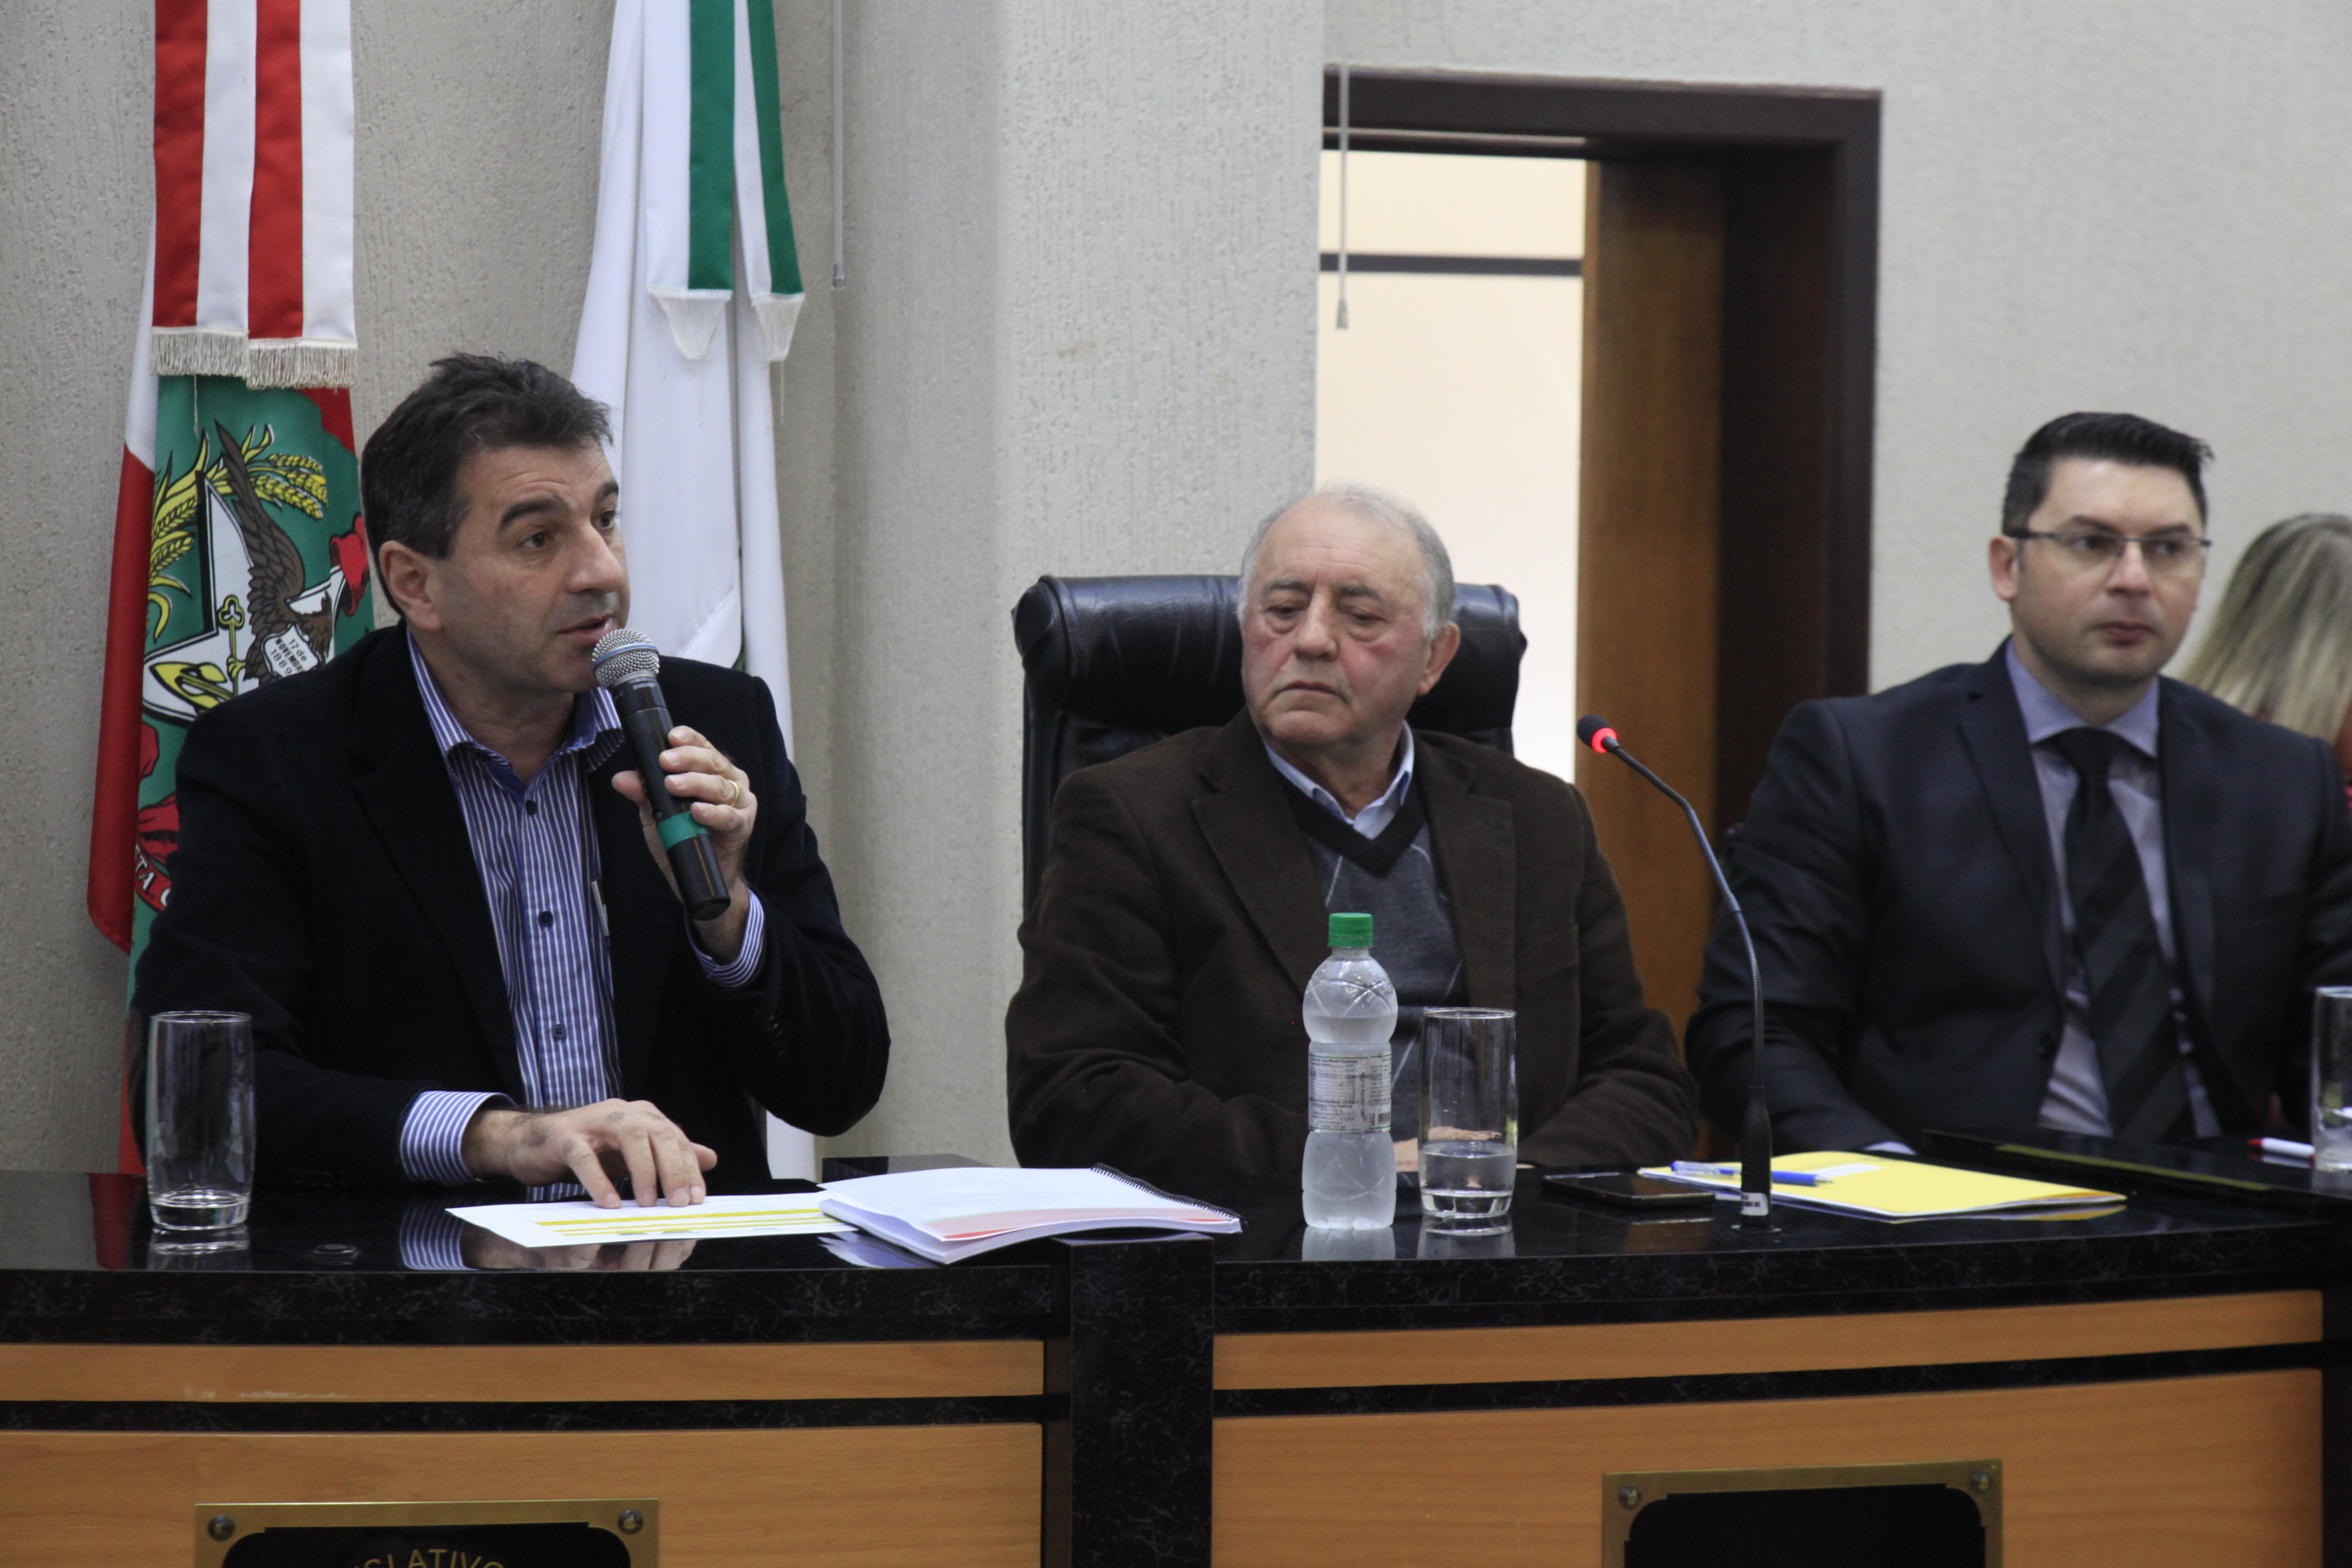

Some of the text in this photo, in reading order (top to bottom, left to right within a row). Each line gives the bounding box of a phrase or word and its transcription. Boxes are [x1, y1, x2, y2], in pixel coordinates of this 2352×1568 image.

[270, 649, 292, 675] 1889
[275, 638, 303, 672] NOVEMBR
[288, 639, 307, 662] 17 de
